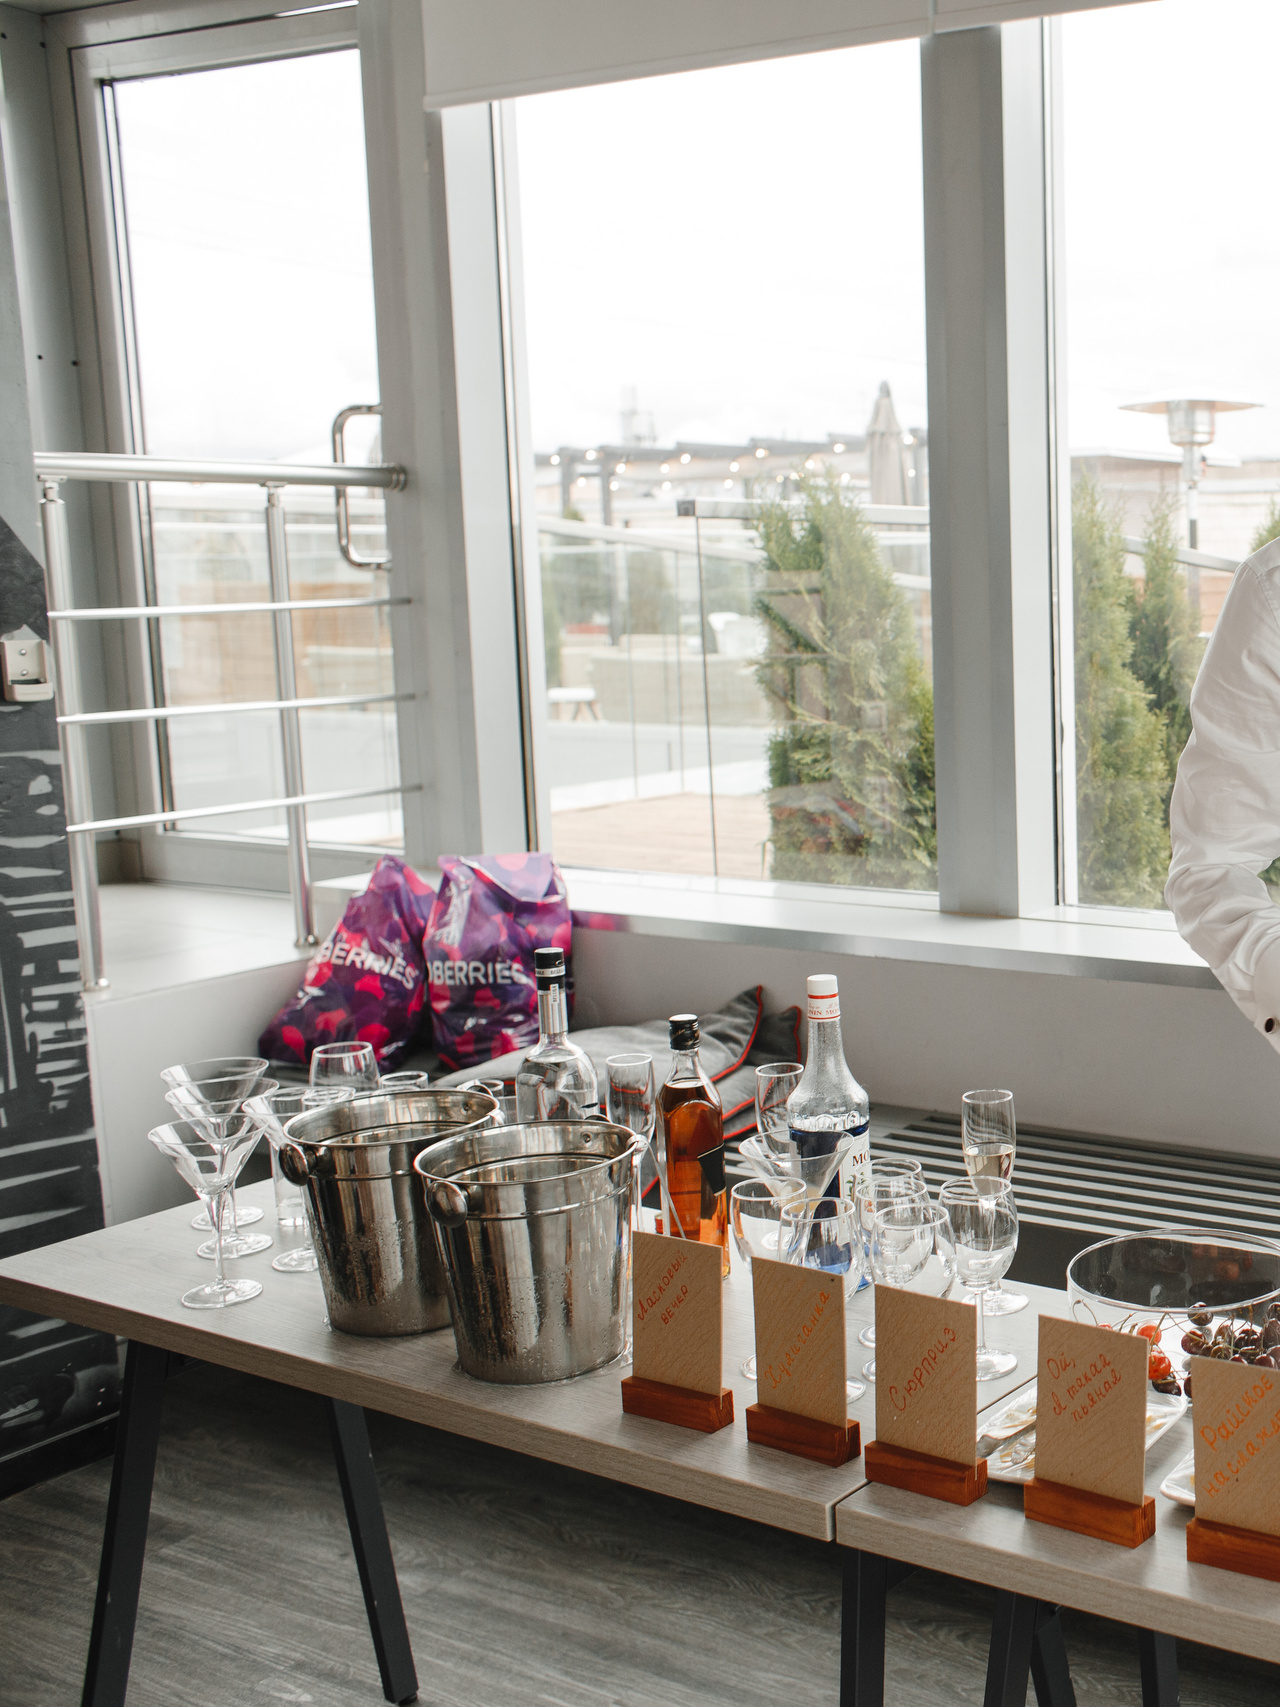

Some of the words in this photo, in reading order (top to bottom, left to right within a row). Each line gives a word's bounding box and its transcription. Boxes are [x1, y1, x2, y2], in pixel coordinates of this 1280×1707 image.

[765, 1291, 830, 1389] Хулиганка
[1066, 1353, 1111, 1400] такая
[1071, 1368, 1121, 1422] пьяная
